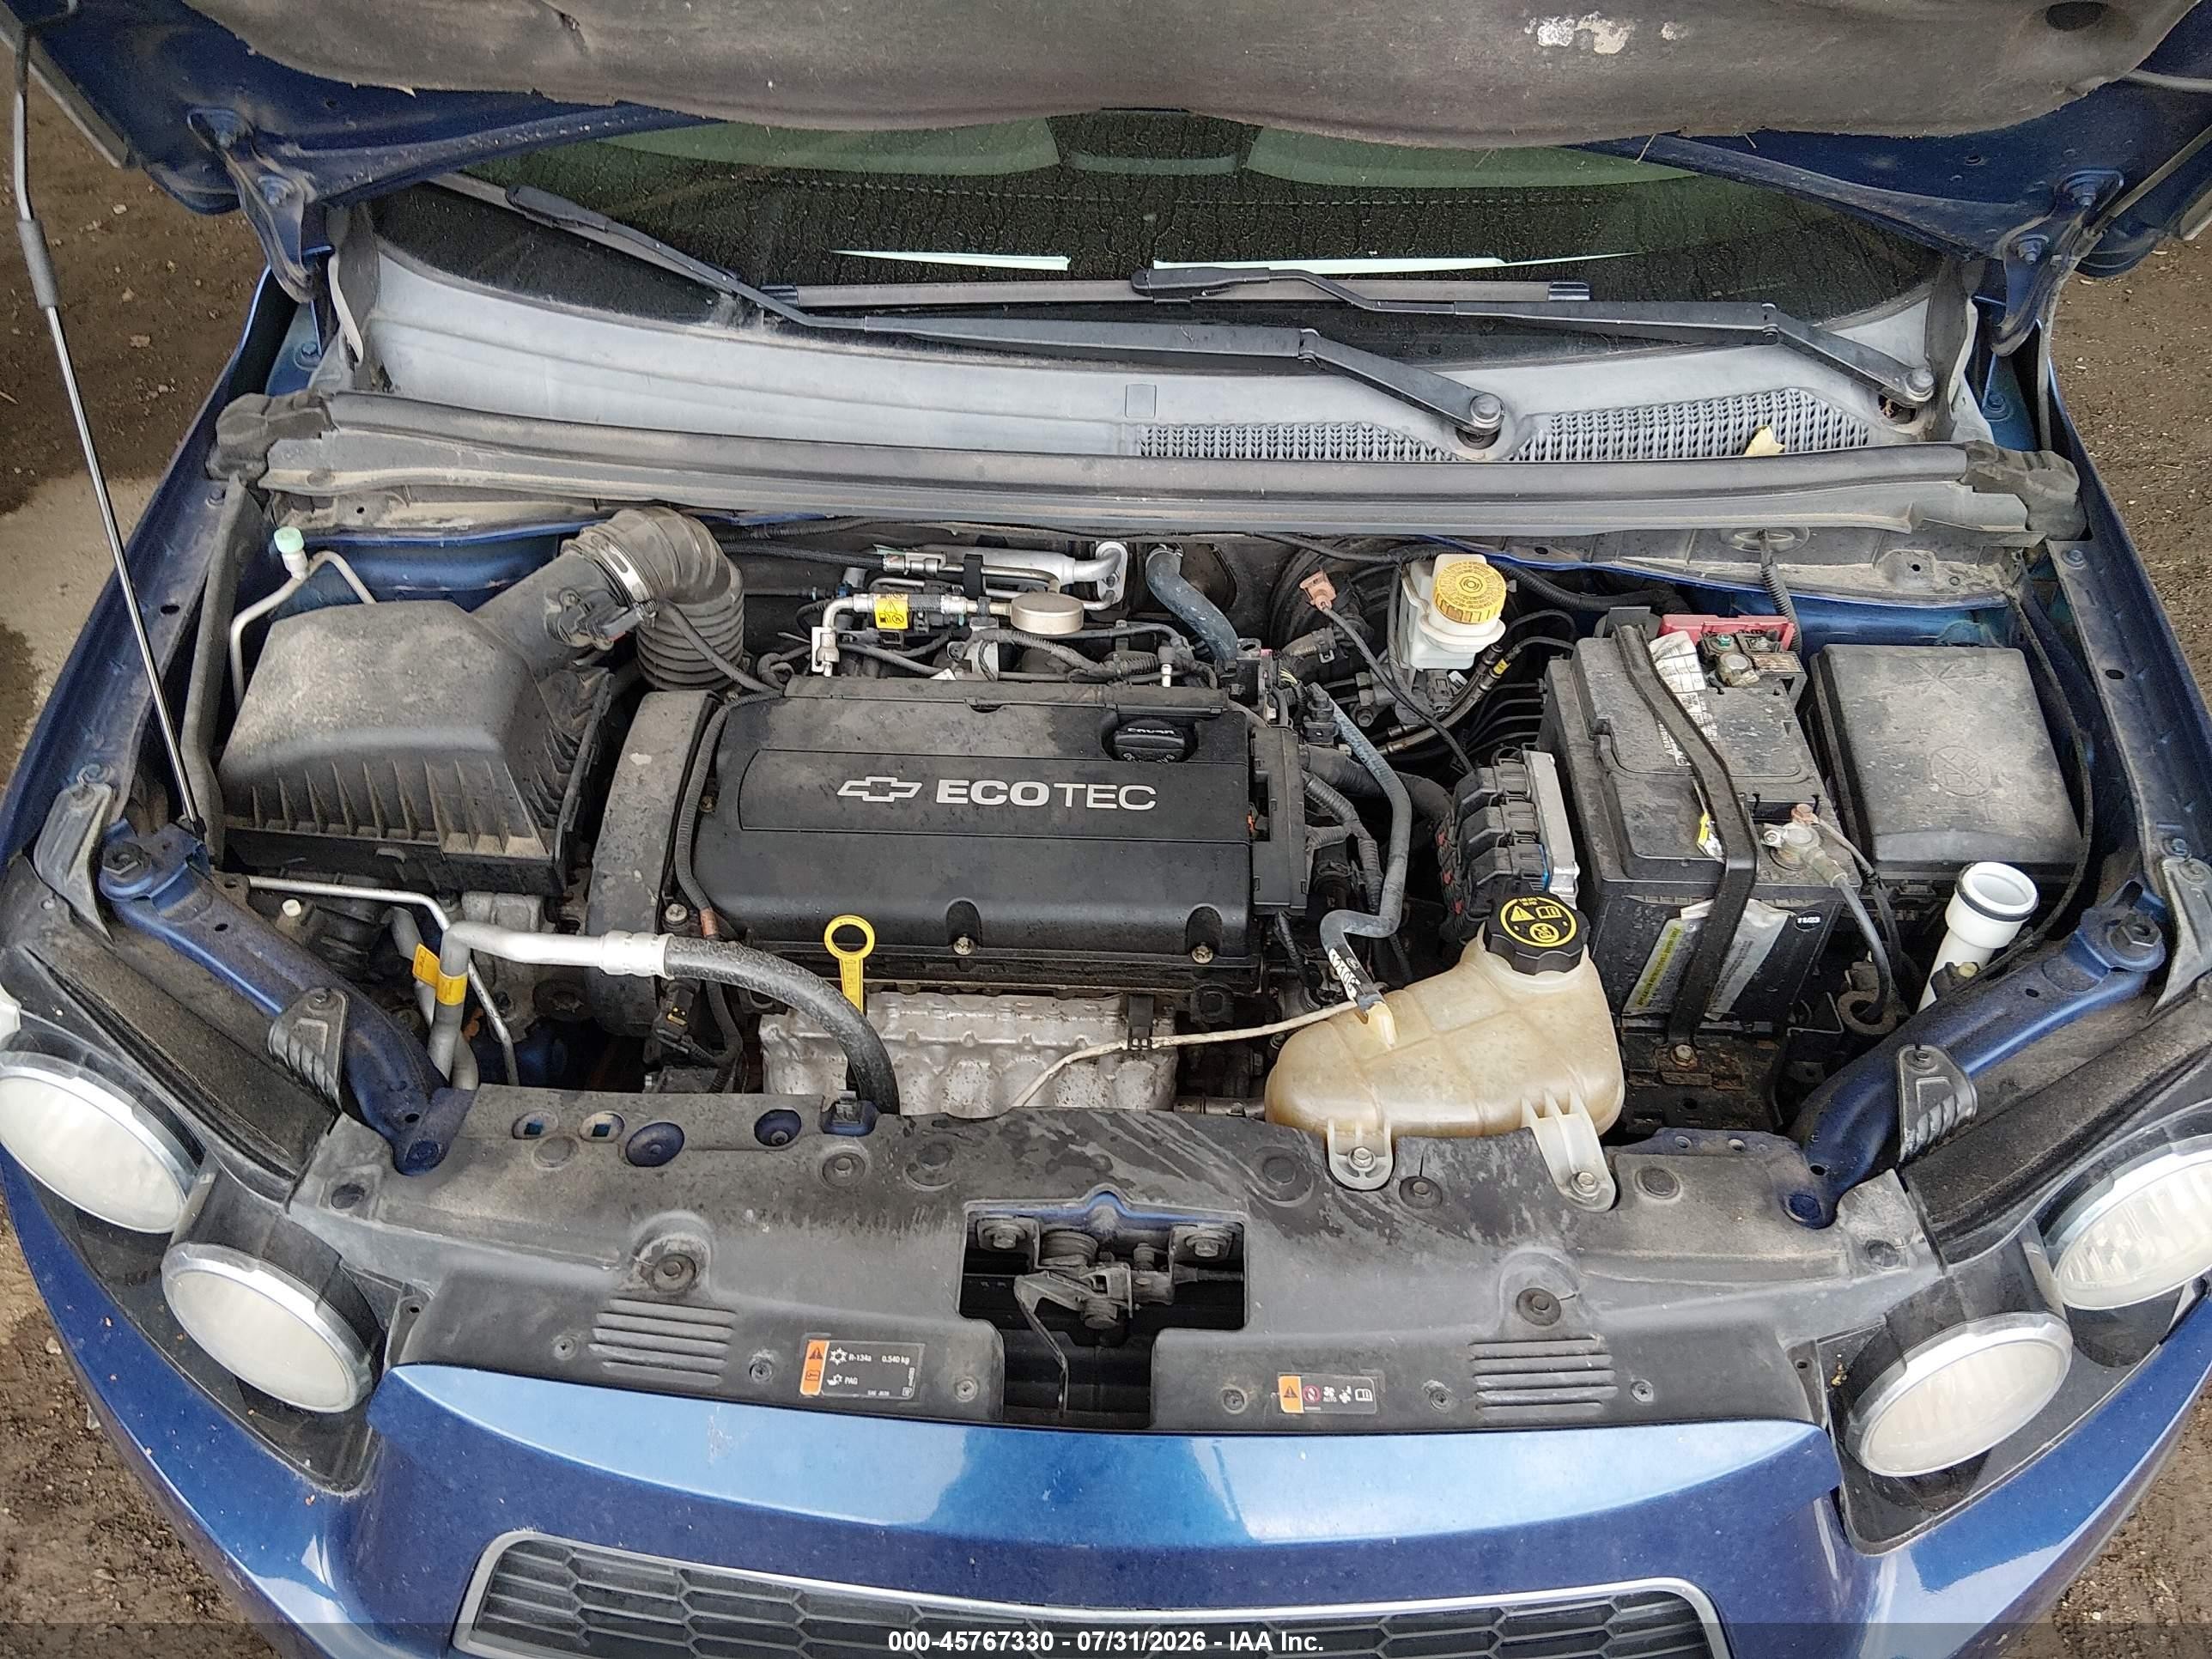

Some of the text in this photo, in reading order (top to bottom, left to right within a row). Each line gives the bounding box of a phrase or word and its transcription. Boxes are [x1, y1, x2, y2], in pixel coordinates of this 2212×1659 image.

[935, 779, 1157, 811] ECOTEC
[848, 1353, 910, 1365] R-134a 0.540 kg
